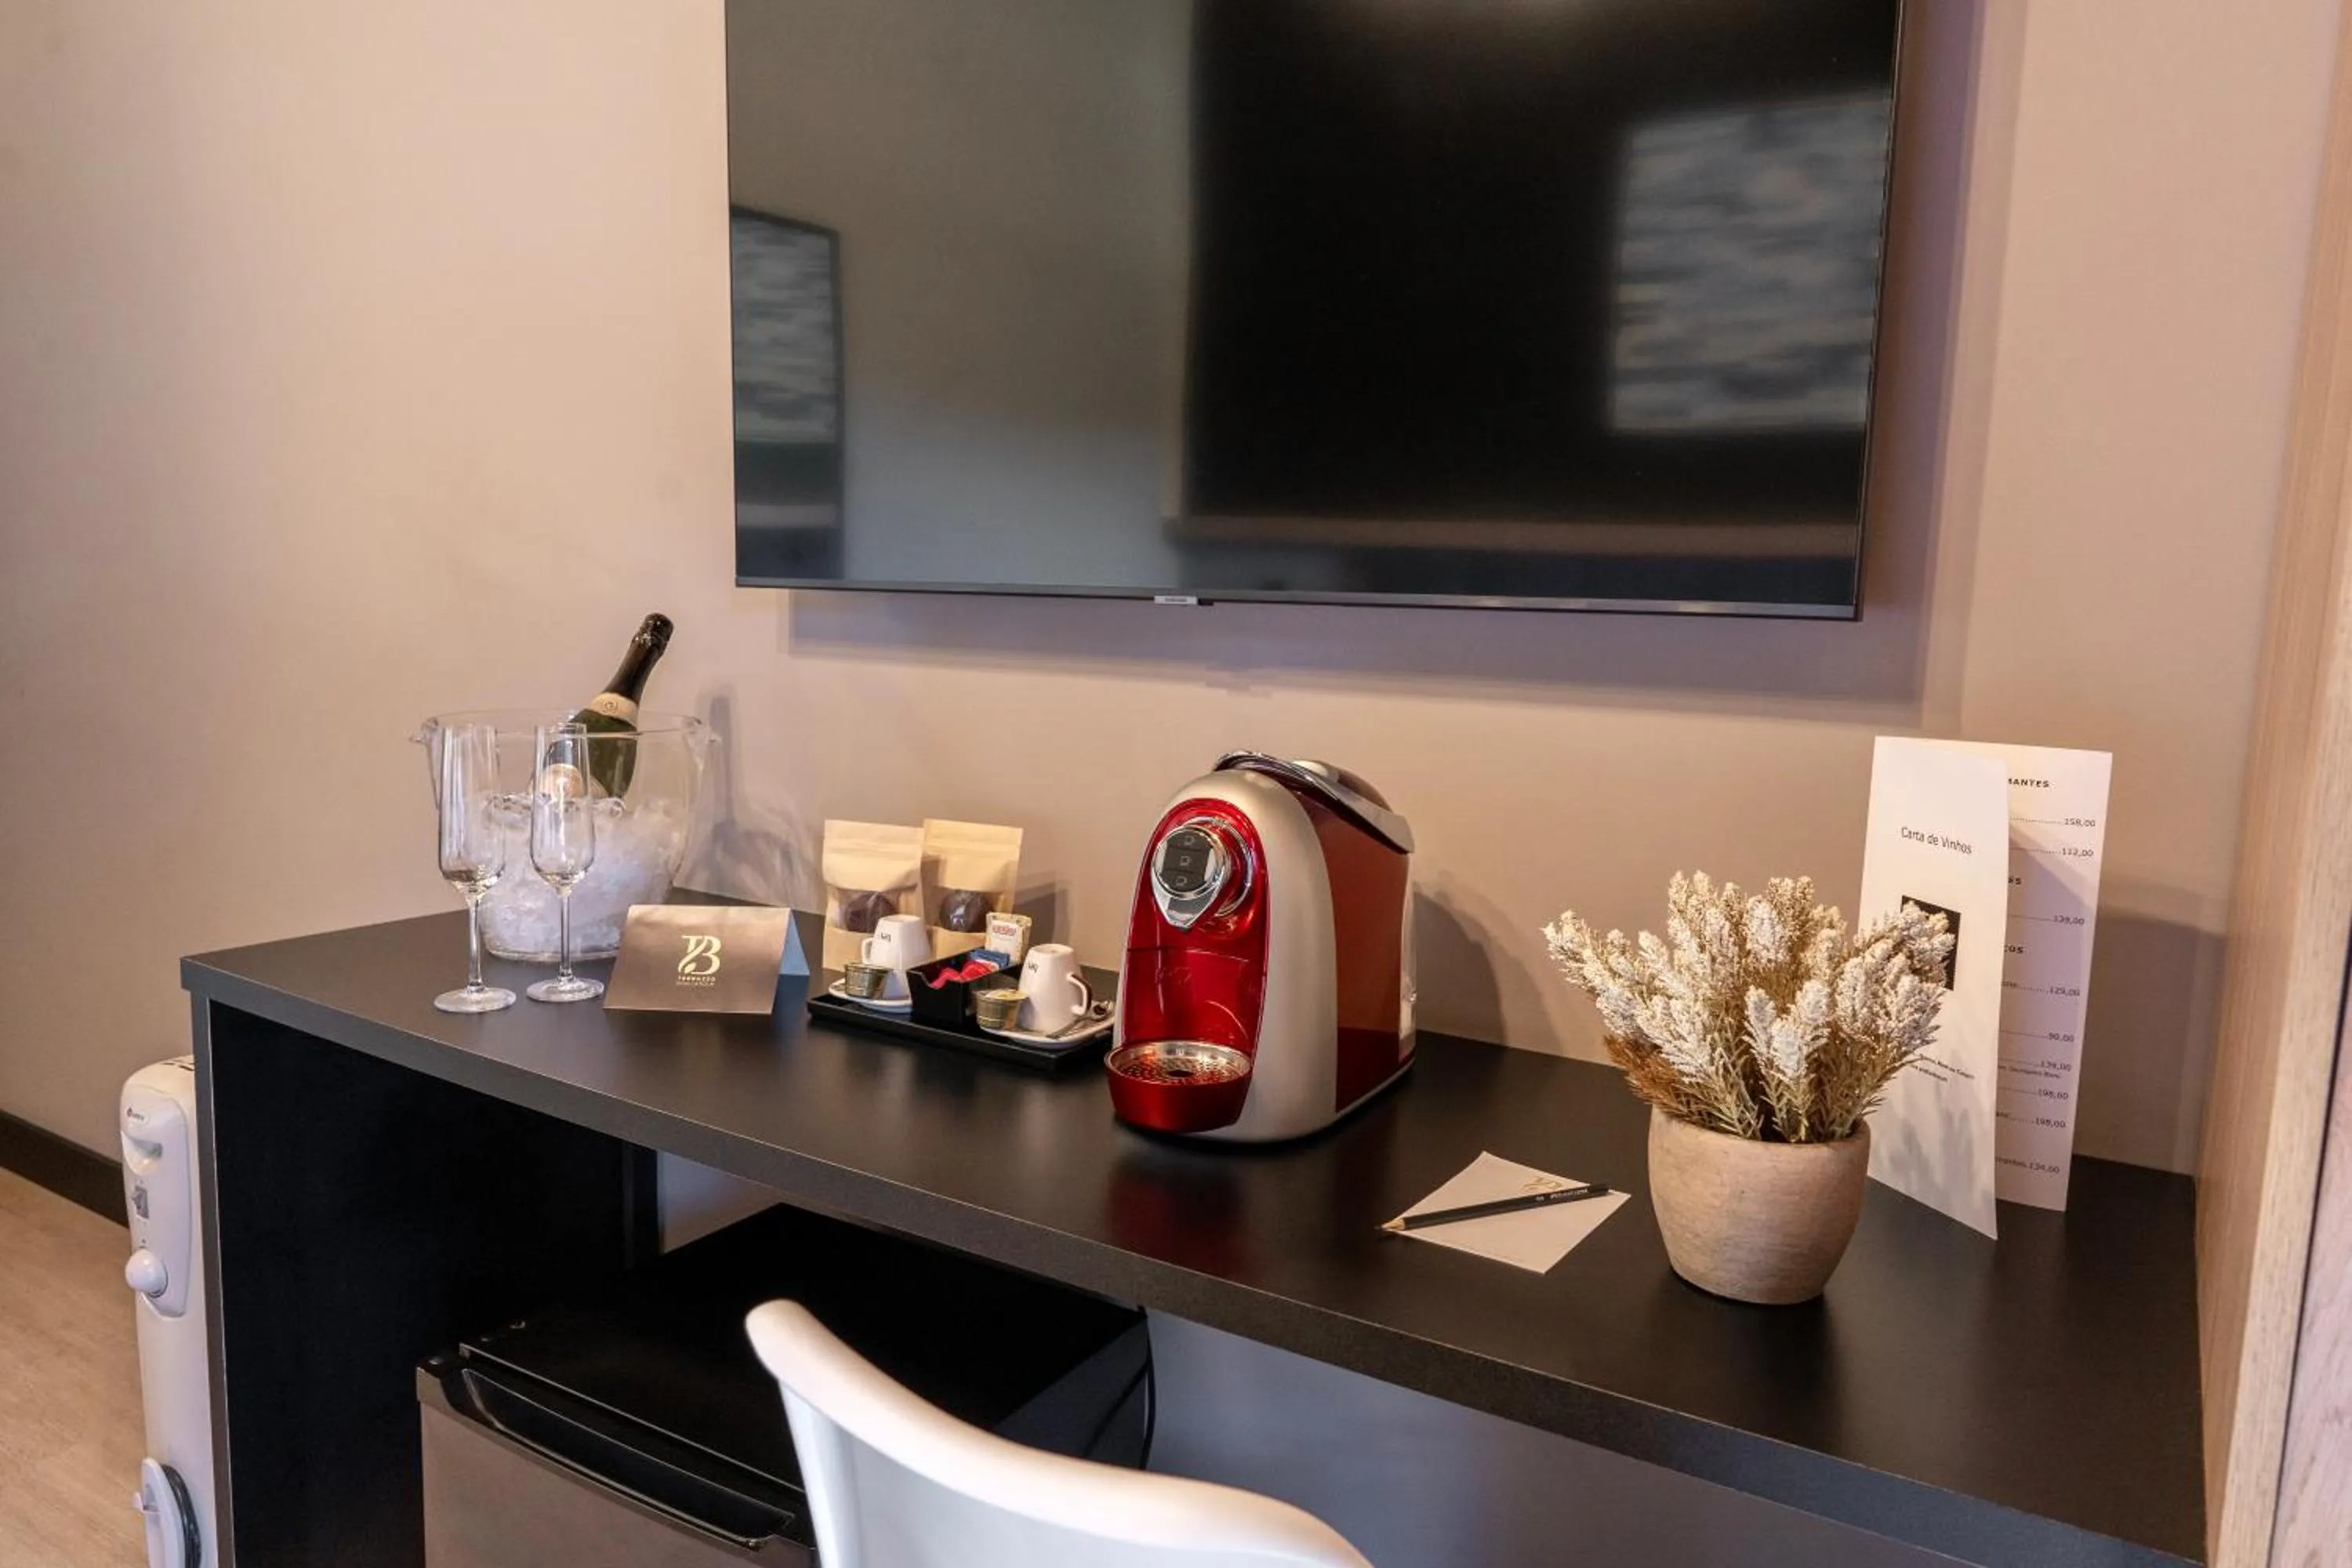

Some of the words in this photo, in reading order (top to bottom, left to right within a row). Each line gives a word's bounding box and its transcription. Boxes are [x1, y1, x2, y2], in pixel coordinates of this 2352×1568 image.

[1900, 826, 1925, 843] Carta
[1926, 833, 1939, 846] de
[1940, 836, 1972, 855] Vinhos
